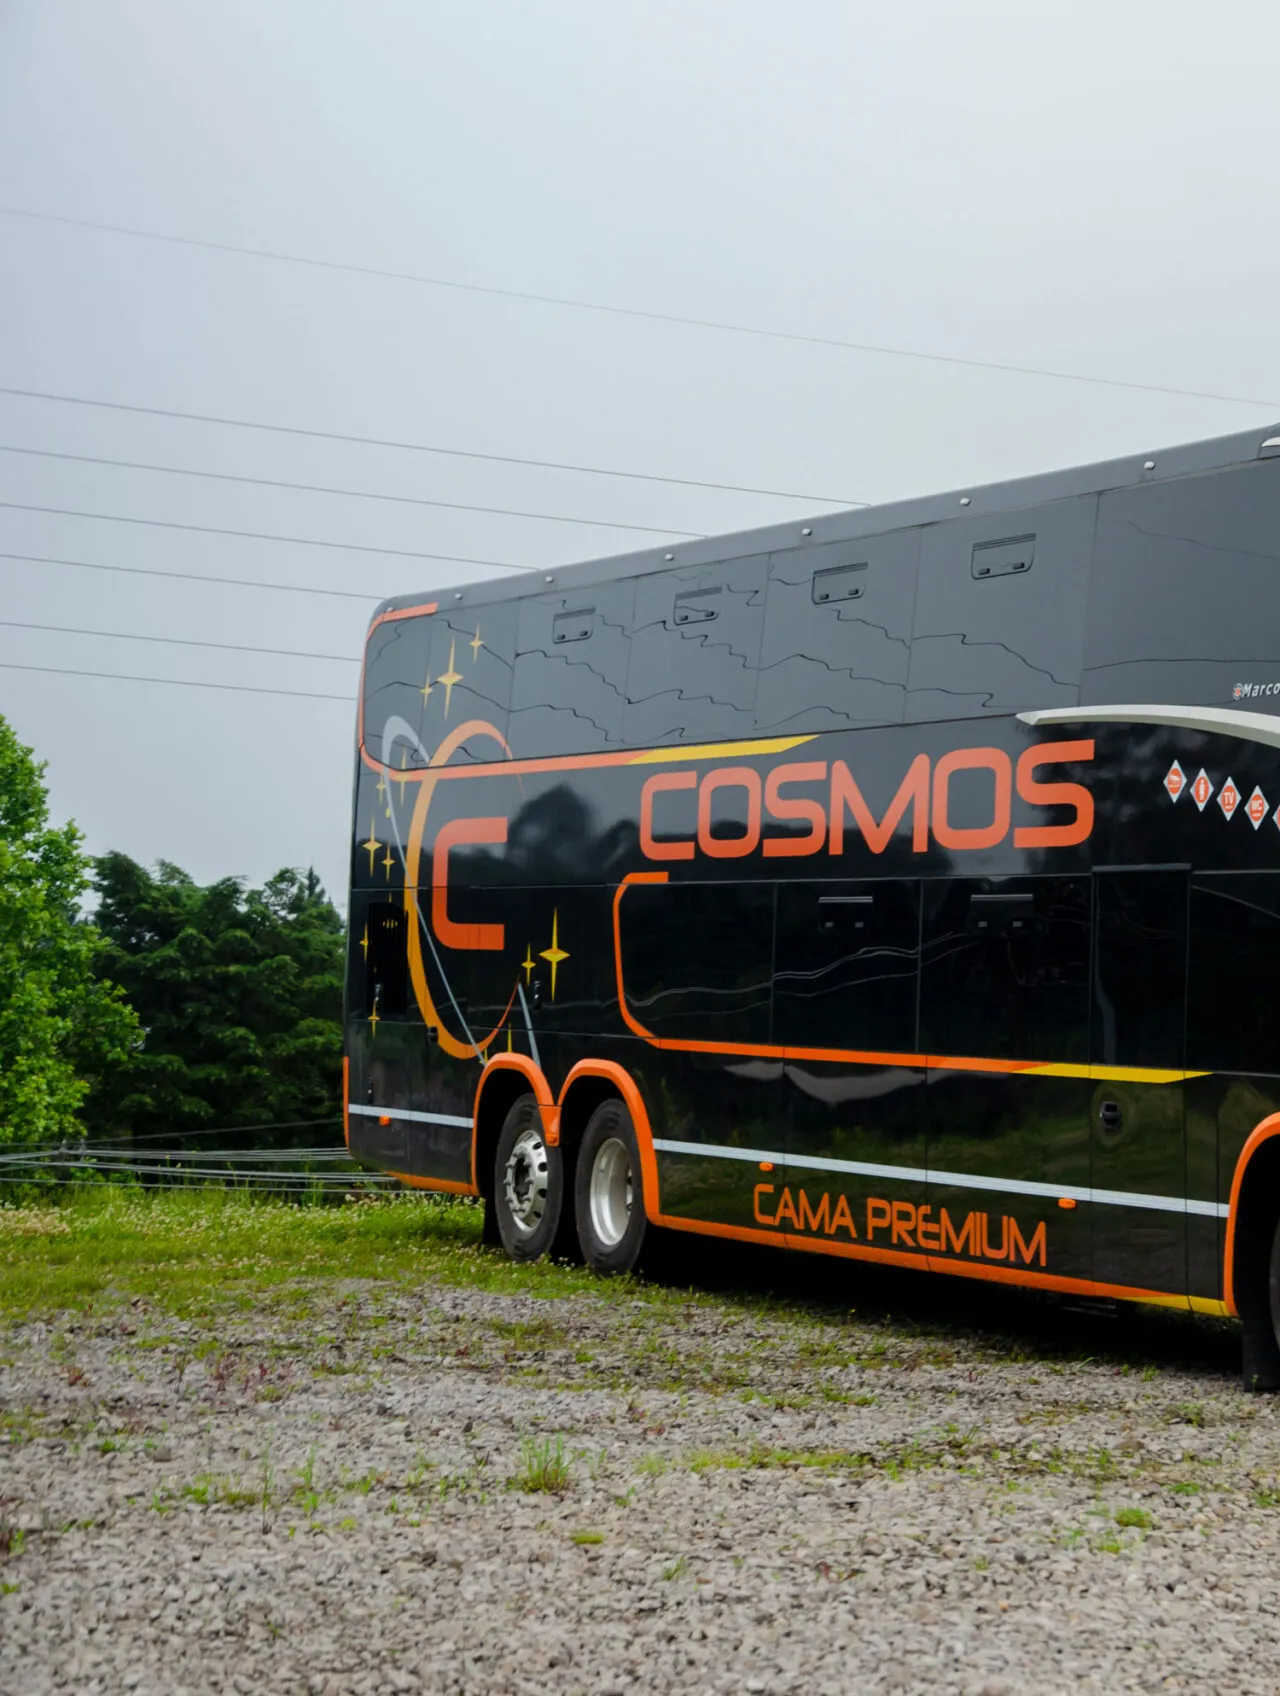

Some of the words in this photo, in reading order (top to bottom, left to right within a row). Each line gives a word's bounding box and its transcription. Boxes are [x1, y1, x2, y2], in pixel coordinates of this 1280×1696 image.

[639, 739, 1095, 861] COSMOS
[1223, 791, 1234, 805] TV
[1251, 799, 1263, 811] WC
[753, 1183, 857, 1239] CAMA
[866, 1197, 1046, 1267] PREMIUM
